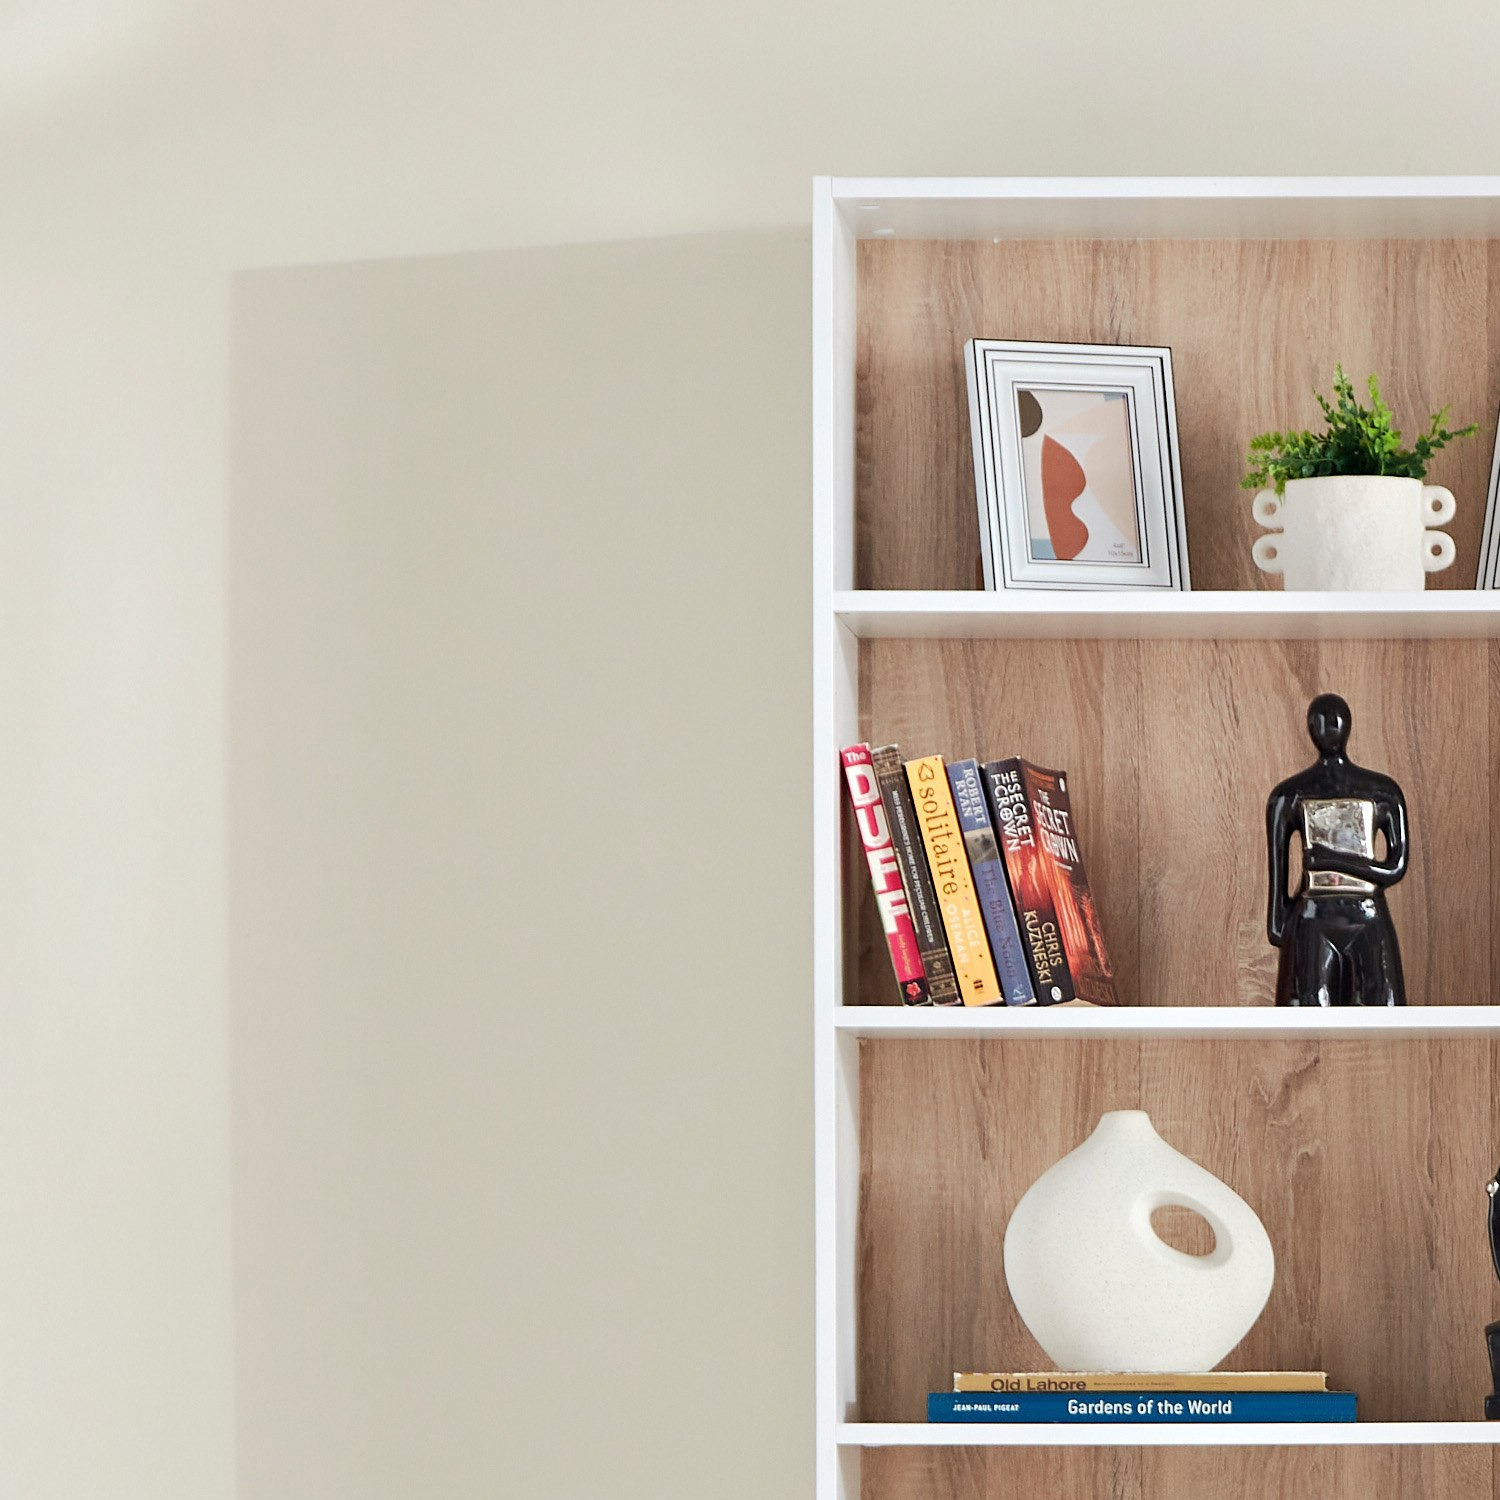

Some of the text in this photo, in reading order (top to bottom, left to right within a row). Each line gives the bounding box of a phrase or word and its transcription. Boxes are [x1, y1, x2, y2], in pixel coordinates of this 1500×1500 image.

[845, 752, 866, 763] The
[991, 771, 1018, 785] THE
[955, 780, 973, 817] RYAN
[963, 768, 986, 824] ROBERT
[1007, 783, 1035, 848] SECRET
[919, 786, 958, 895] solitaire
[995, 785, 1021, 852] CROWN
[845, 764, 909, 934] DUFF
[946, 904, 969, 963] OSEMAN
[962, 908, 980, 948] ALICE
[1023, 910, 1052, 984] KUZNESKI
[1042, 922, 1062, 966] CHRIS
[991, 1379, 1087, 1391] Old Lahore
[1067, 1399, 1232, 1415] Gardens of the World
[953, 1404, 1019, 1412] JEAN-PAUL PIGEAT
